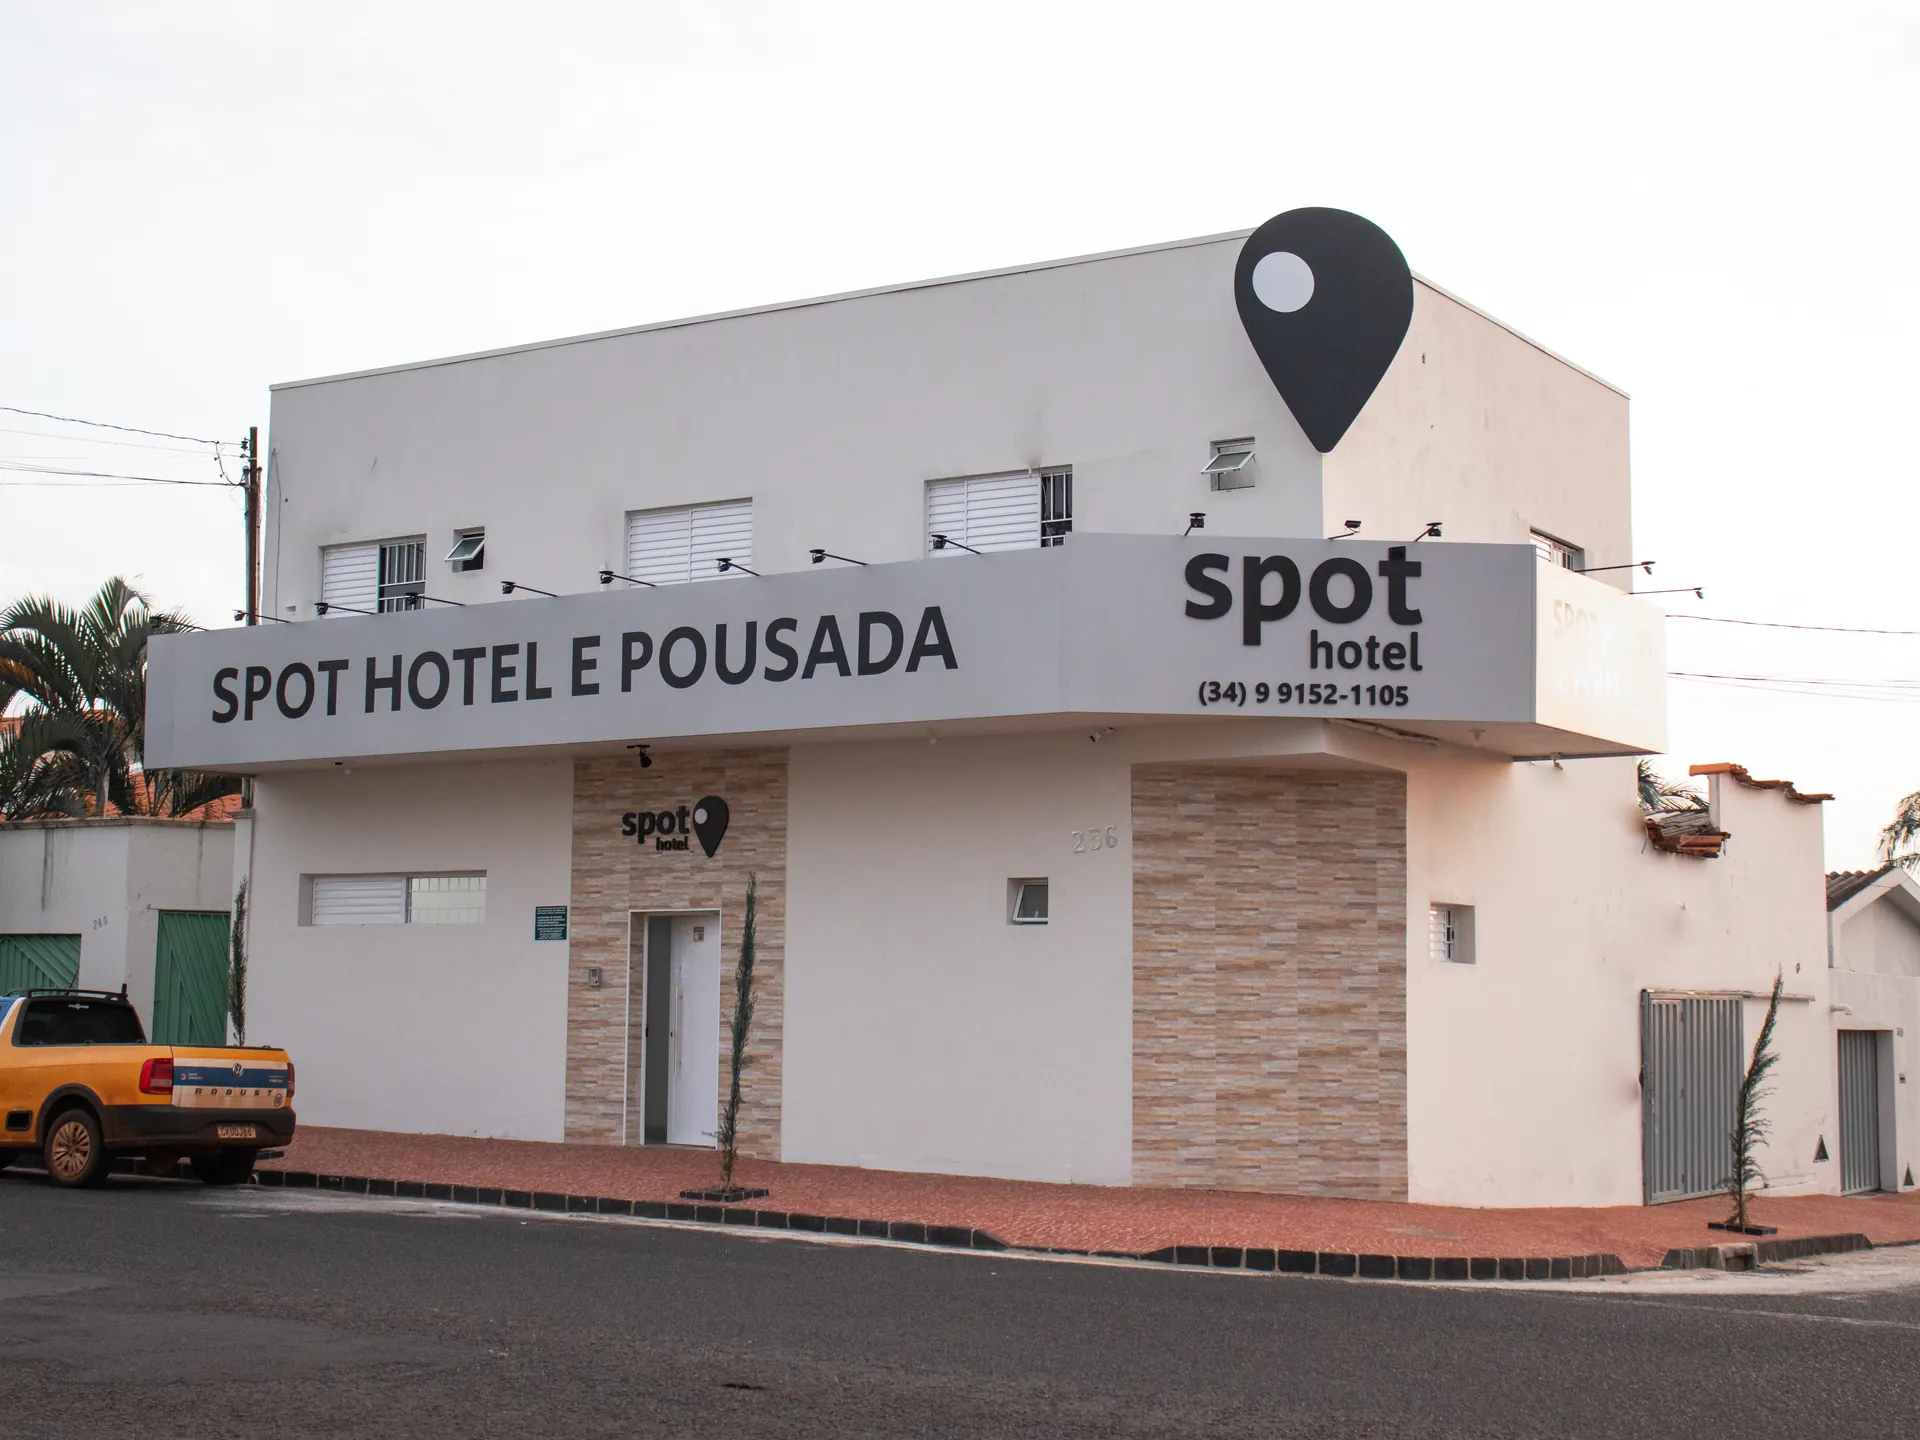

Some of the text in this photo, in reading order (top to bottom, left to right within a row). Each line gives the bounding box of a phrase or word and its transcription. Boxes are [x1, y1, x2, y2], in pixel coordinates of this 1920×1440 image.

[1184, 545, 1424, 647] spot
[211, 605, 958, 724] SPOT HOTEL E POUSADA
[1309, 629, 1424, 672] hotel
[1198, 680, 1409, 708] (34) 9 9152-1105
[621, 805, 691, 845] spot
[655, 835, 690, 851] hotel
[194, 1087, 273, 1097] ROBUST
